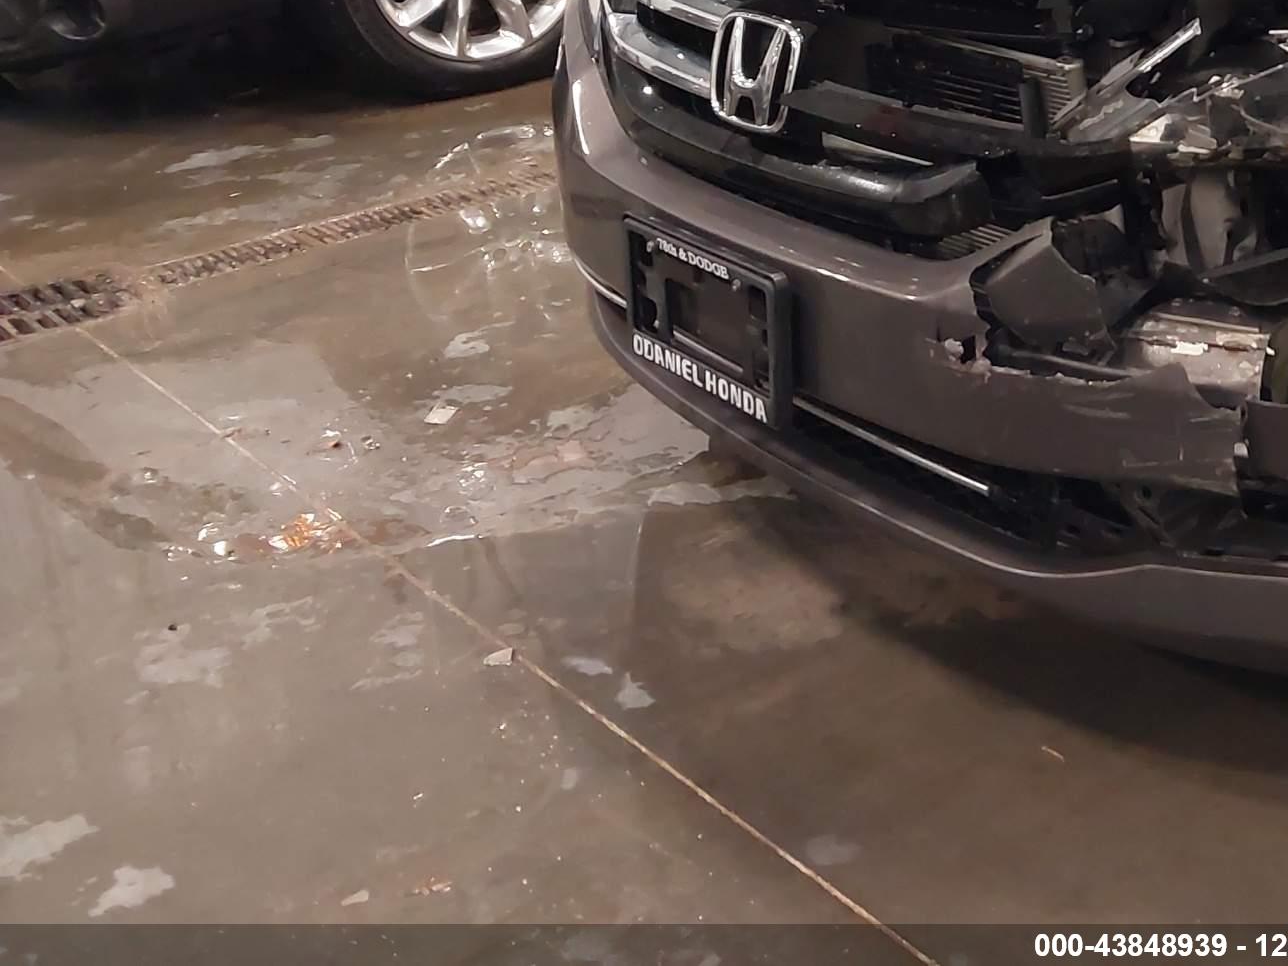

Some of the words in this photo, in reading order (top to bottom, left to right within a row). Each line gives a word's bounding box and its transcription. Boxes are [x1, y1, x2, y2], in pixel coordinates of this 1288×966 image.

[687, 250, 729, 280] DODGE
[632, 333, 704, 388] ODANIEL
[705, 370, 767, 424] HONDA
